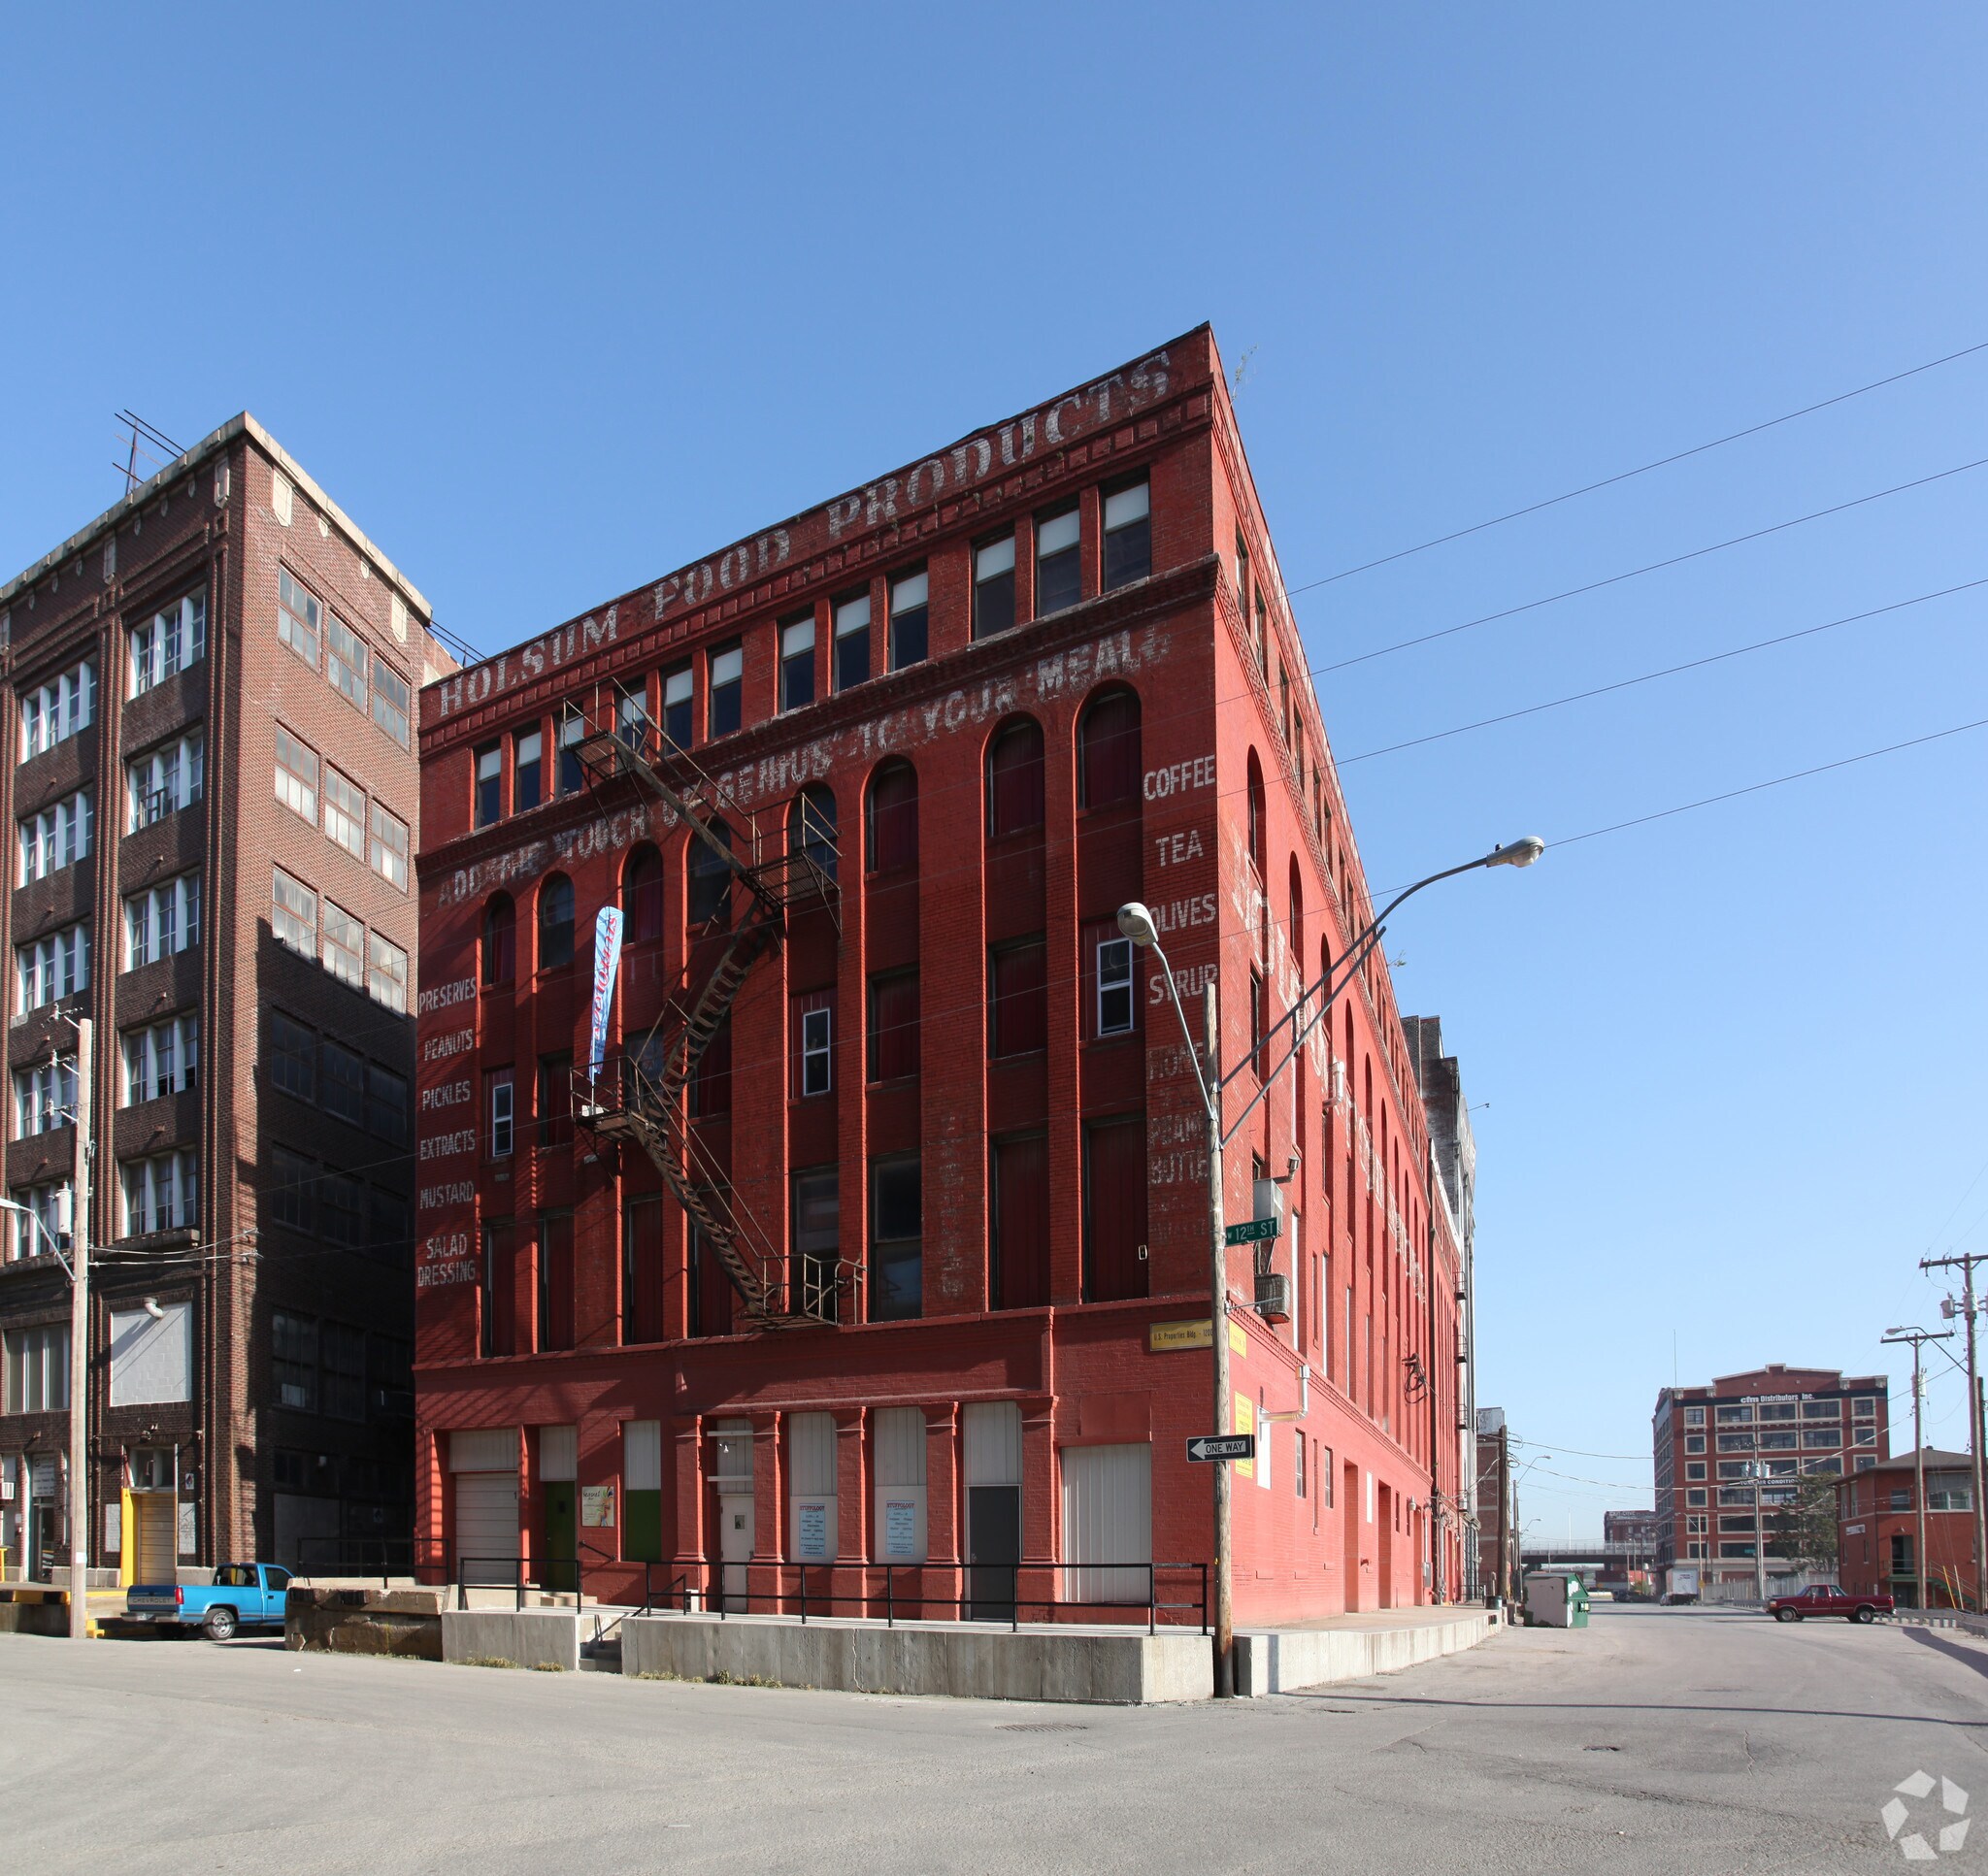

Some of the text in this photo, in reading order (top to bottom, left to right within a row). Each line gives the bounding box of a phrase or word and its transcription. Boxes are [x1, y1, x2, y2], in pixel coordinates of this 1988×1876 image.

[439, 349, 1171, 716] HOLSUM FOOD PRODUCTS
[1143, 755, 1215, 801] COFFEE
[1156, 829, 1204, 868] TEA
[1149, 893, 1216, 933] OLIVES
[418, 976, 477, 1013] PRESERVES
[1149, 964, 1218, 1004] SYRUP
[424, 1028, 474, 1061] PEANUTS
[422, 1080, 471, 1111] PICKLES
[419, 1129, 476, 1161] EXTRACTS
[1150, 1150, 1209, 1185] BUTTE
[419, 1181, 475, 1209] MUSTARD
[426, 1233, 467, 1260] SALAD
[1235, 1224, 1255, 1241] 12TH
[1260, 1220, 1275, 1235] ST
[417, 1260, 476, 1288] DRESSING
[1153, 1333, 1163, 1341] U.S.
[1164, 1331, 1185, 1341] Properties
[1187, 1330, 1197, 1339] Bldg.
[1760, 1394, 1799, 1402] Distributors
[1205, 1441, 1244, 1454] ONE WAY
